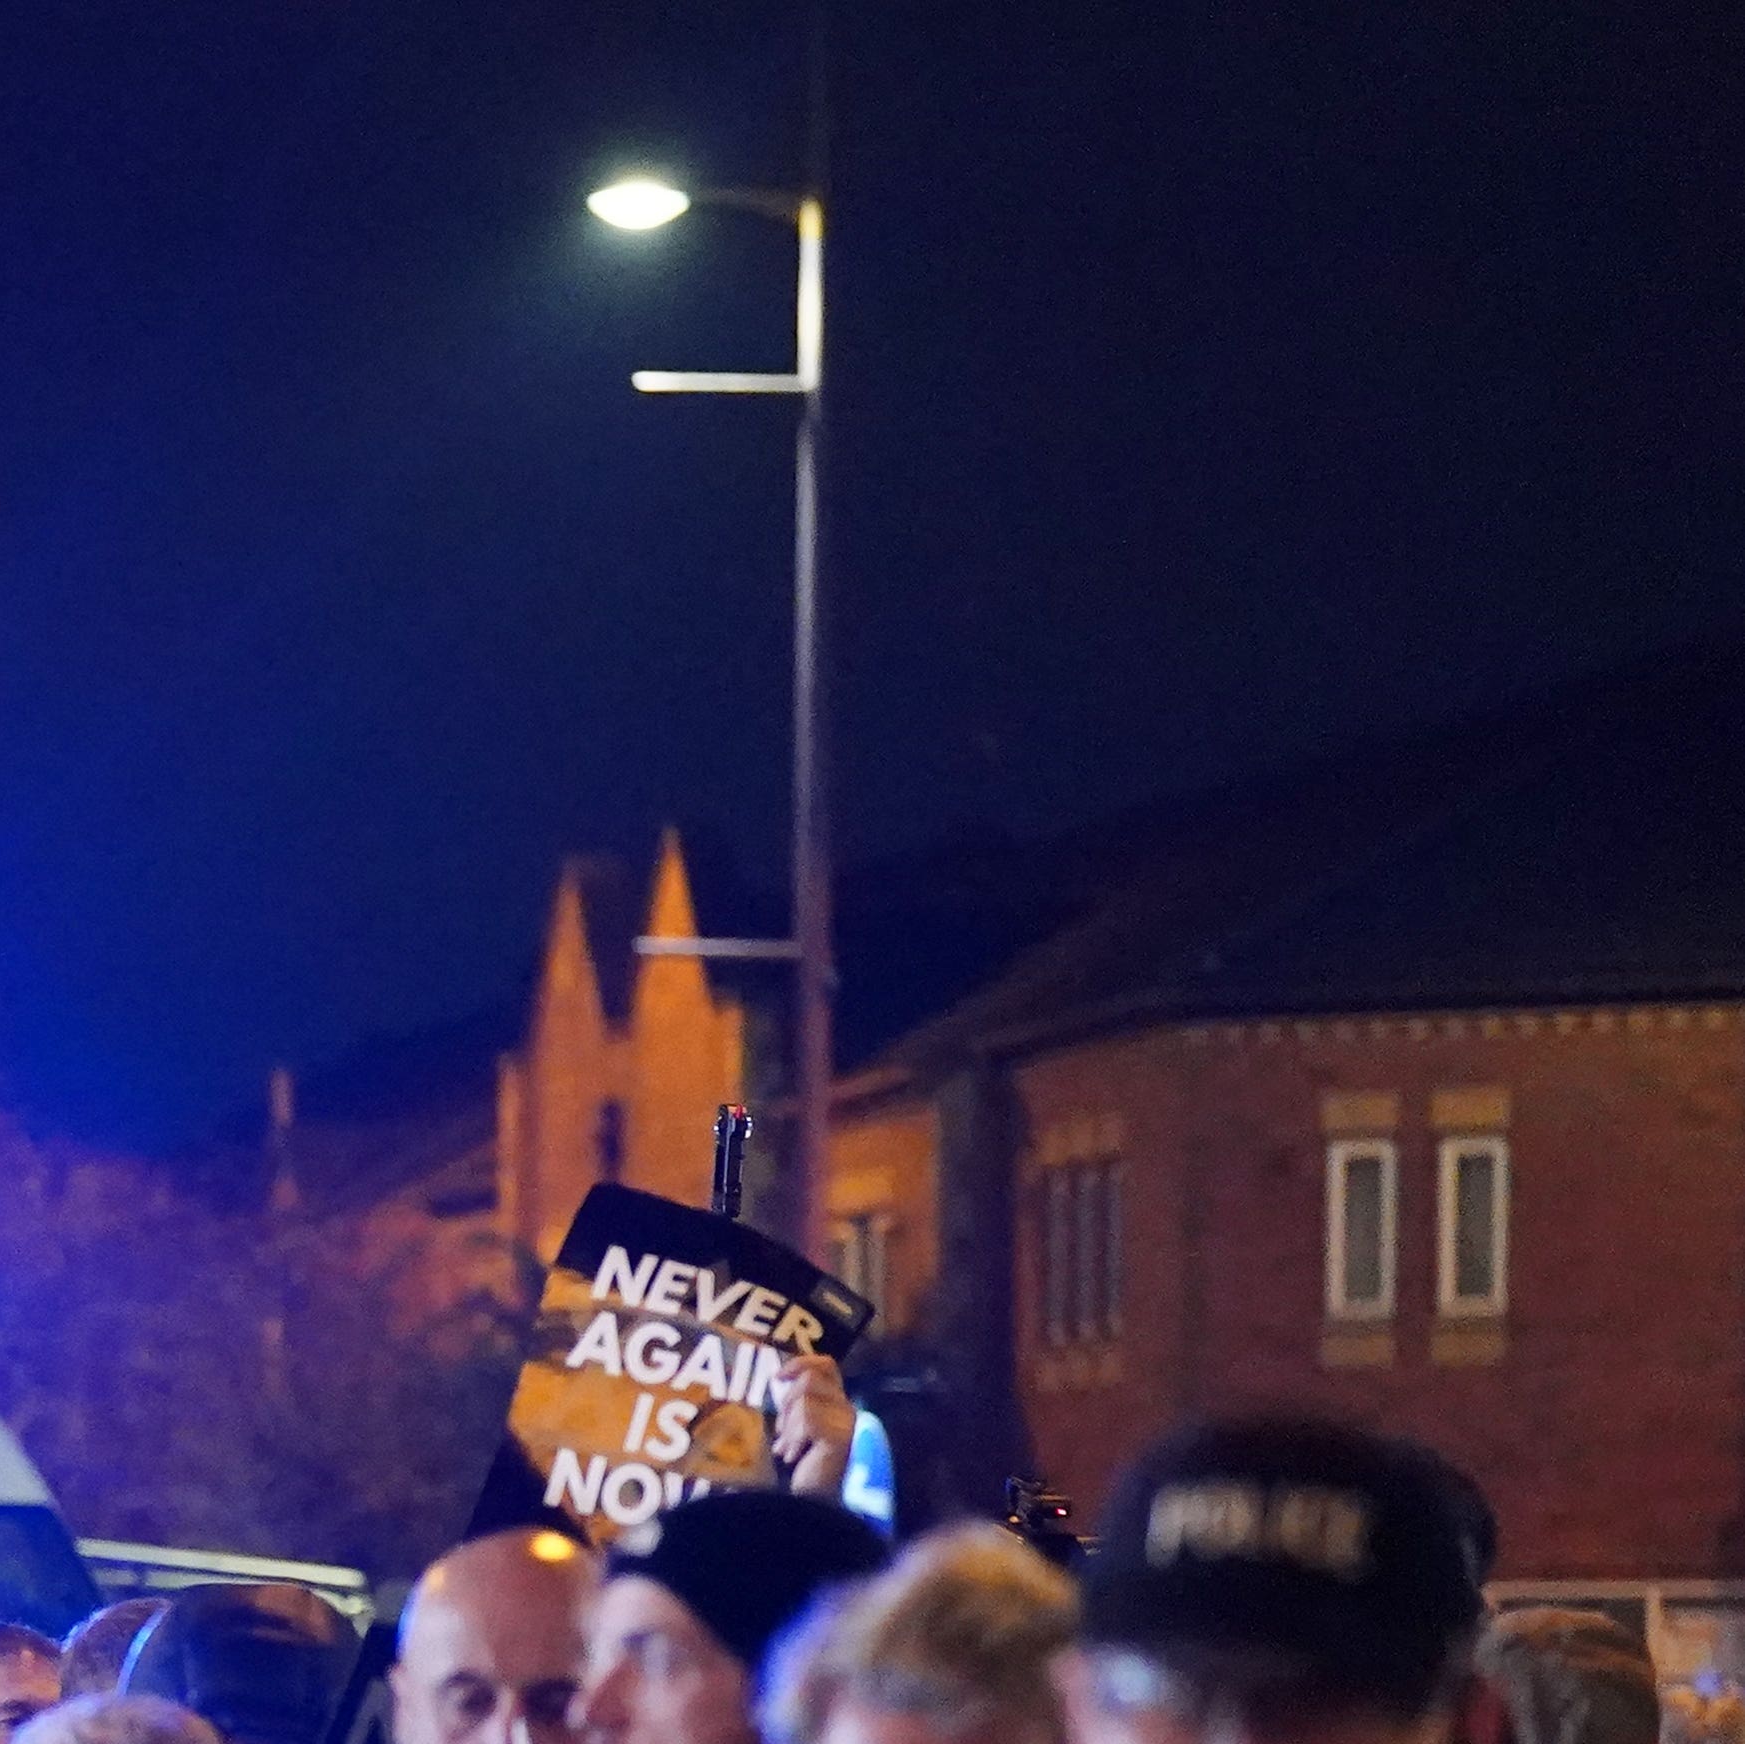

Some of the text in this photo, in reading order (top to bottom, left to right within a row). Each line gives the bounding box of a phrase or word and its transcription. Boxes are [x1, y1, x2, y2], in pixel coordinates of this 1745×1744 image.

[590, 1243, 825, 1356] NEVER
[564, 1310, 791, 1407] AGAIN
[622, 1392, 699, 1463] IS
